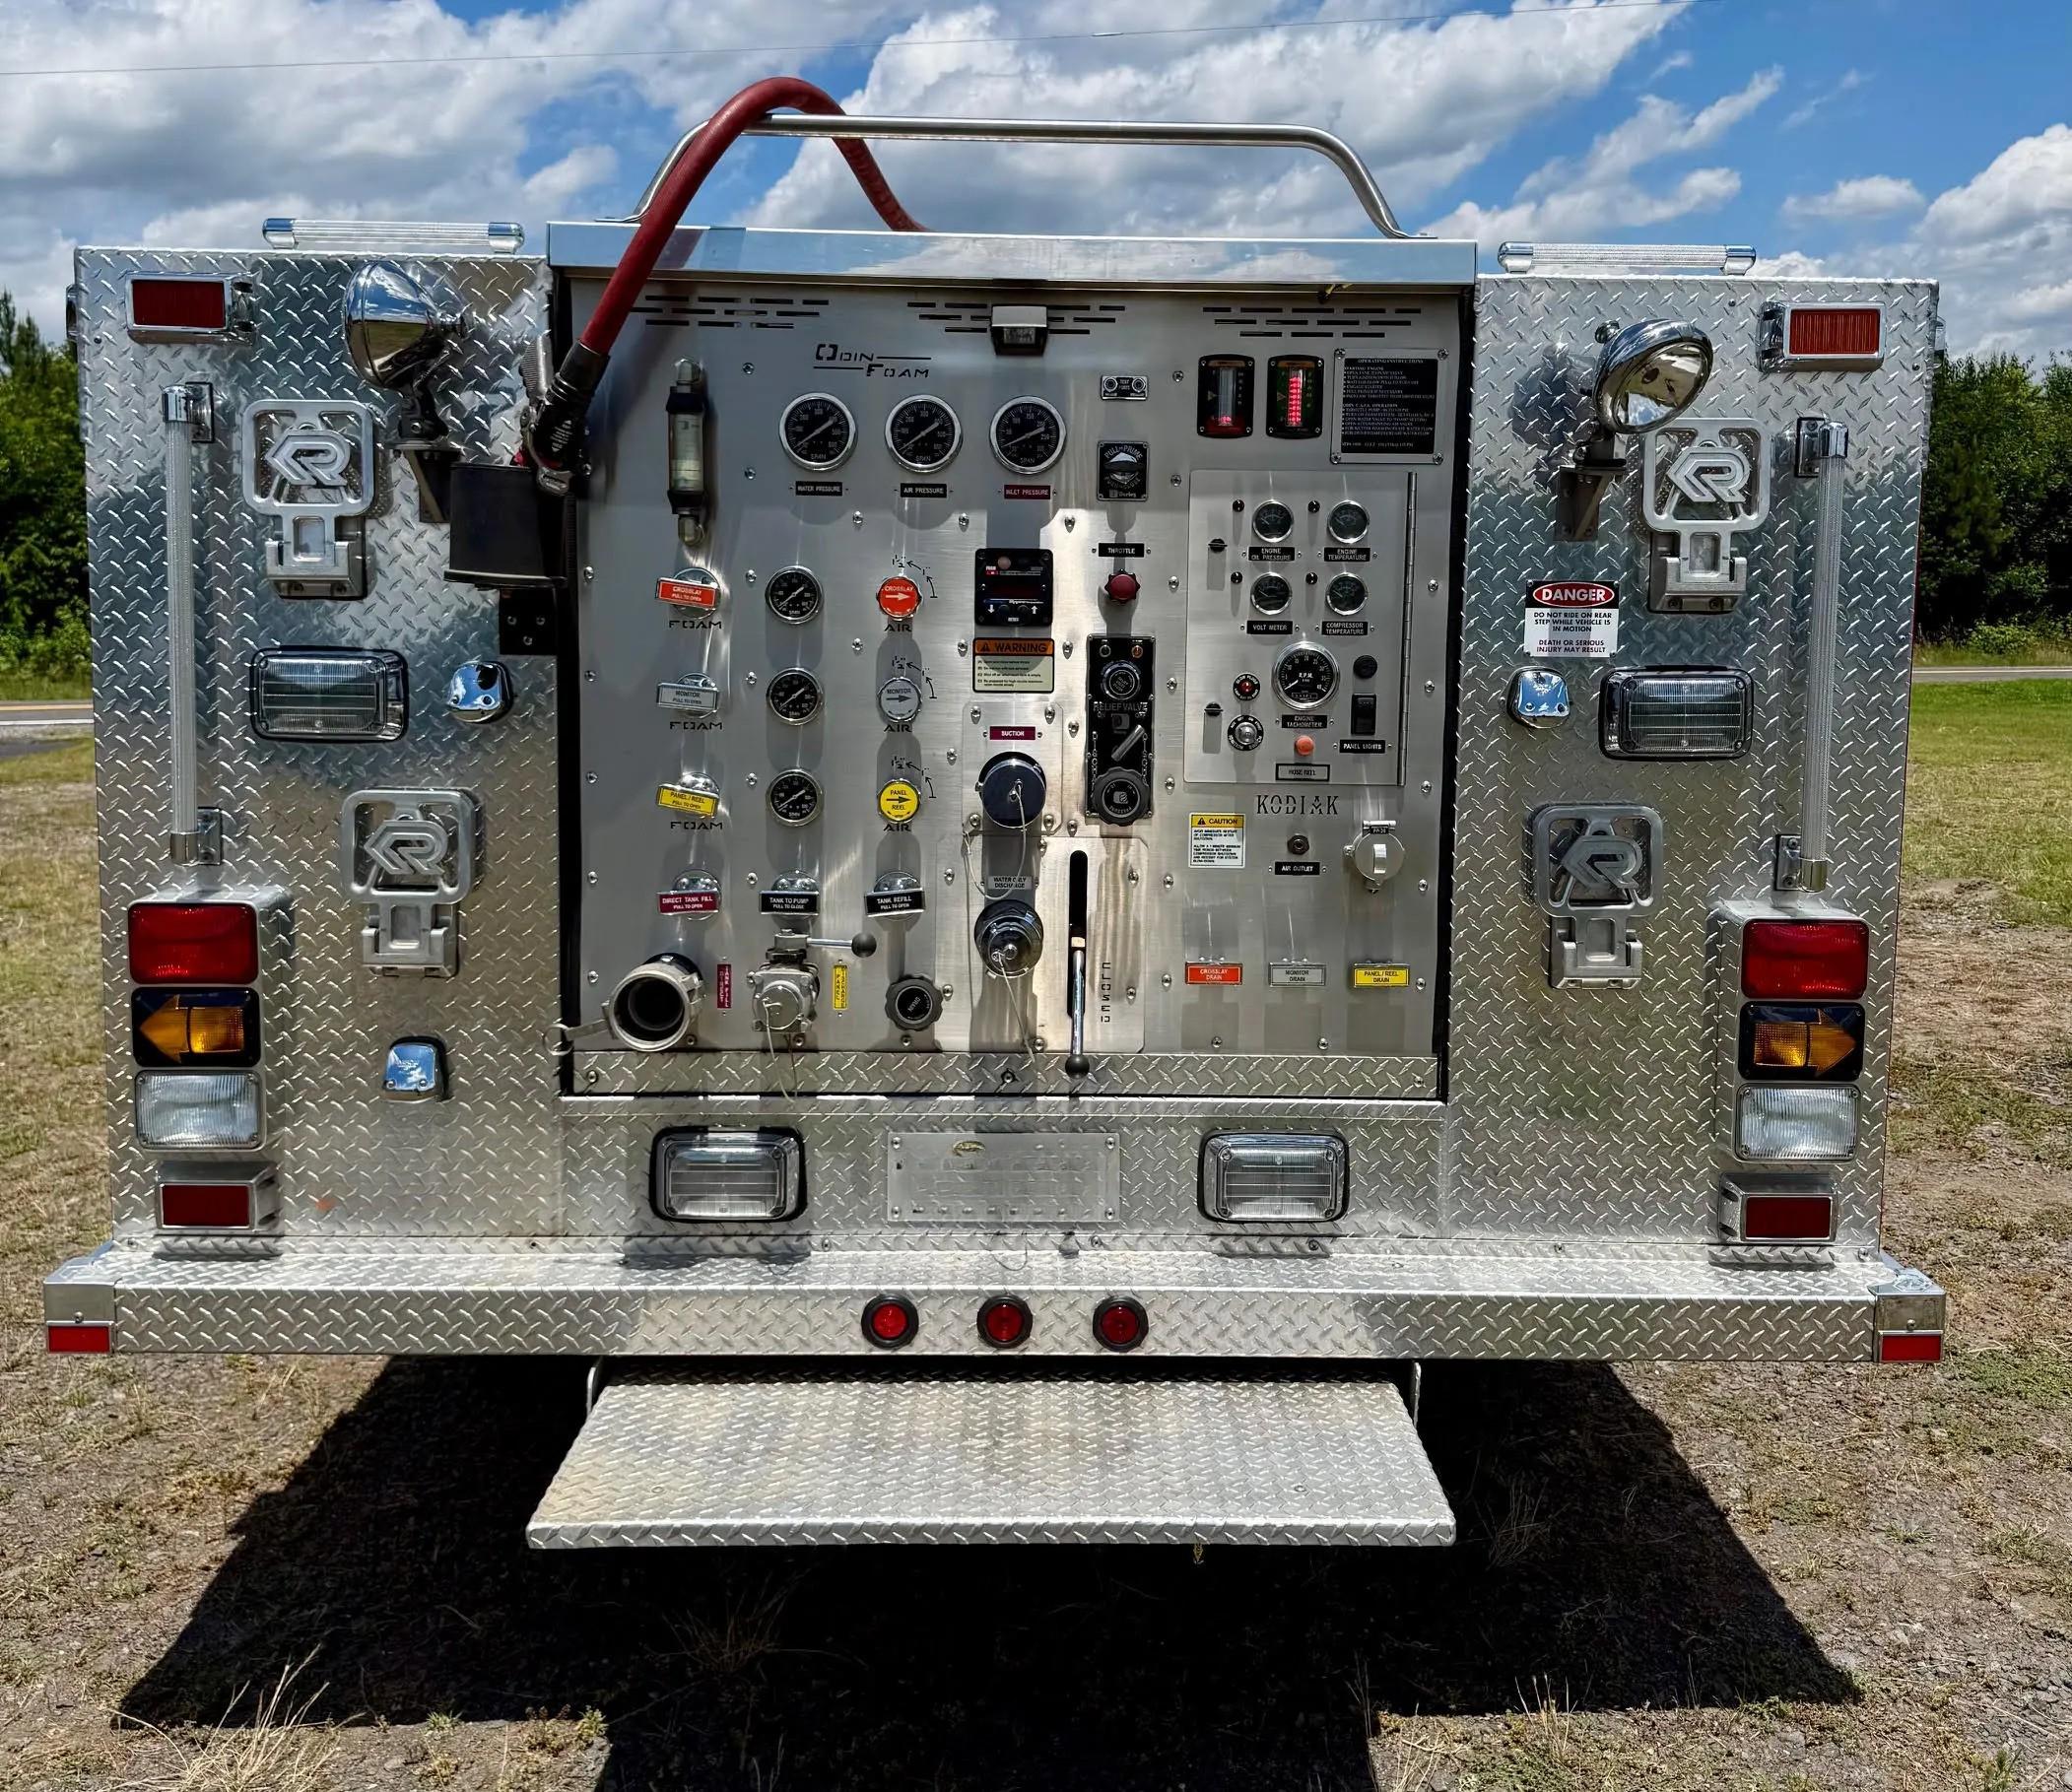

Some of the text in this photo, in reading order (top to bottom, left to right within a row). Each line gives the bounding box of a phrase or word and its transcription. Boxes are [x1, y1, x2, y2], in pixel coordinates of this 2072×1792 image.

[816, 344, 874, 362] ODIN
[866, 364, 929, 377] FOAM
[672, 586, 702, 595] CROSSLAY
[1541, 589, 1606, 601] DANGER
[994, 642, 1047, 652] WARNING
[1094, 701, 1121, 711] RELIEF
[1256, 795, 1339, 815] KODIAK
